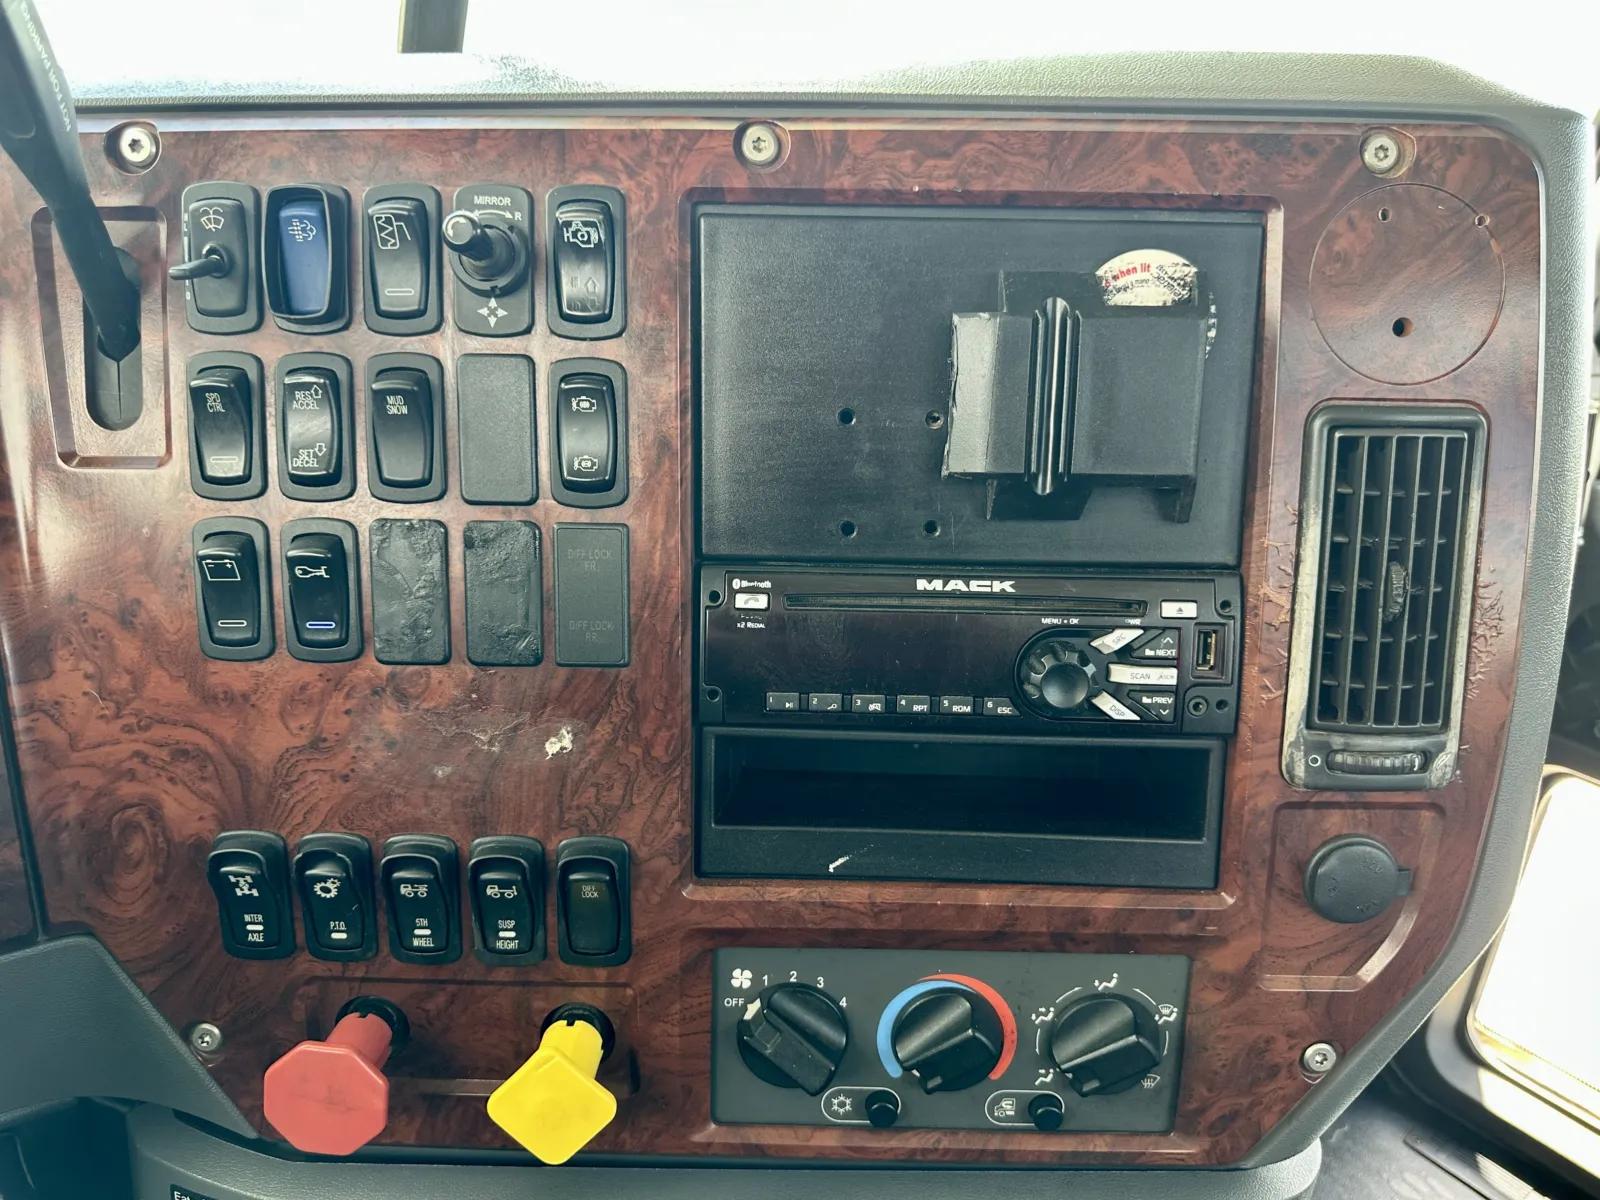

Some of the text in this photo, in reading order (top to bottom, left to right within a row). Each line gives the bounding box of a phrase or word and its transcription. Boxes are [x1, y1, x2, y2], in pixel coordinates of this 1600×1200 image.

[474, 195, 511, 206] MIRROR
[514, 211, 522, 221] R
[1140, 263, 1152, 273] lit
[205, 392, 221, 403] SPD
[295, 391, 312, 401] RES
[386, 395, 404, 406] MUD
[207, 402, 226, 413] CTRL
[292, 400, 320, 410] ACCEL
[386, 405, 408, 415] SNOW
[298, 449, 315, 460] SET
[292, 458, 320, 468] DECEL
[567, 549, 611, 560] DIFF LOCK
[916, 578, 1016, 593] MACK
[568, 620, 589, 631] DIFF
[1041, 617, 1062, 625] MENU
[1155, 649, 1177, 657] NEXT
[1129, 672, 1151, 680] SCAN
[1152, 696, 1174, 704] PREV
[952, 705, 971, 713] RDM
[1109, 704, 1126, 717] DISP
[243, 914, 264, 923] INTER
[415, 918, 429, 927] 5TH
[498, 919, 516, 929] SUSP
[247, 932, 265, 942] AXLE
[412, 937, 434, 947] WHEEL
[496, 939, 519, 949] HEIGHT
[762, 971, 848, 1008] 1 2 3 4
[724, 997, 745, 1008] OFF
